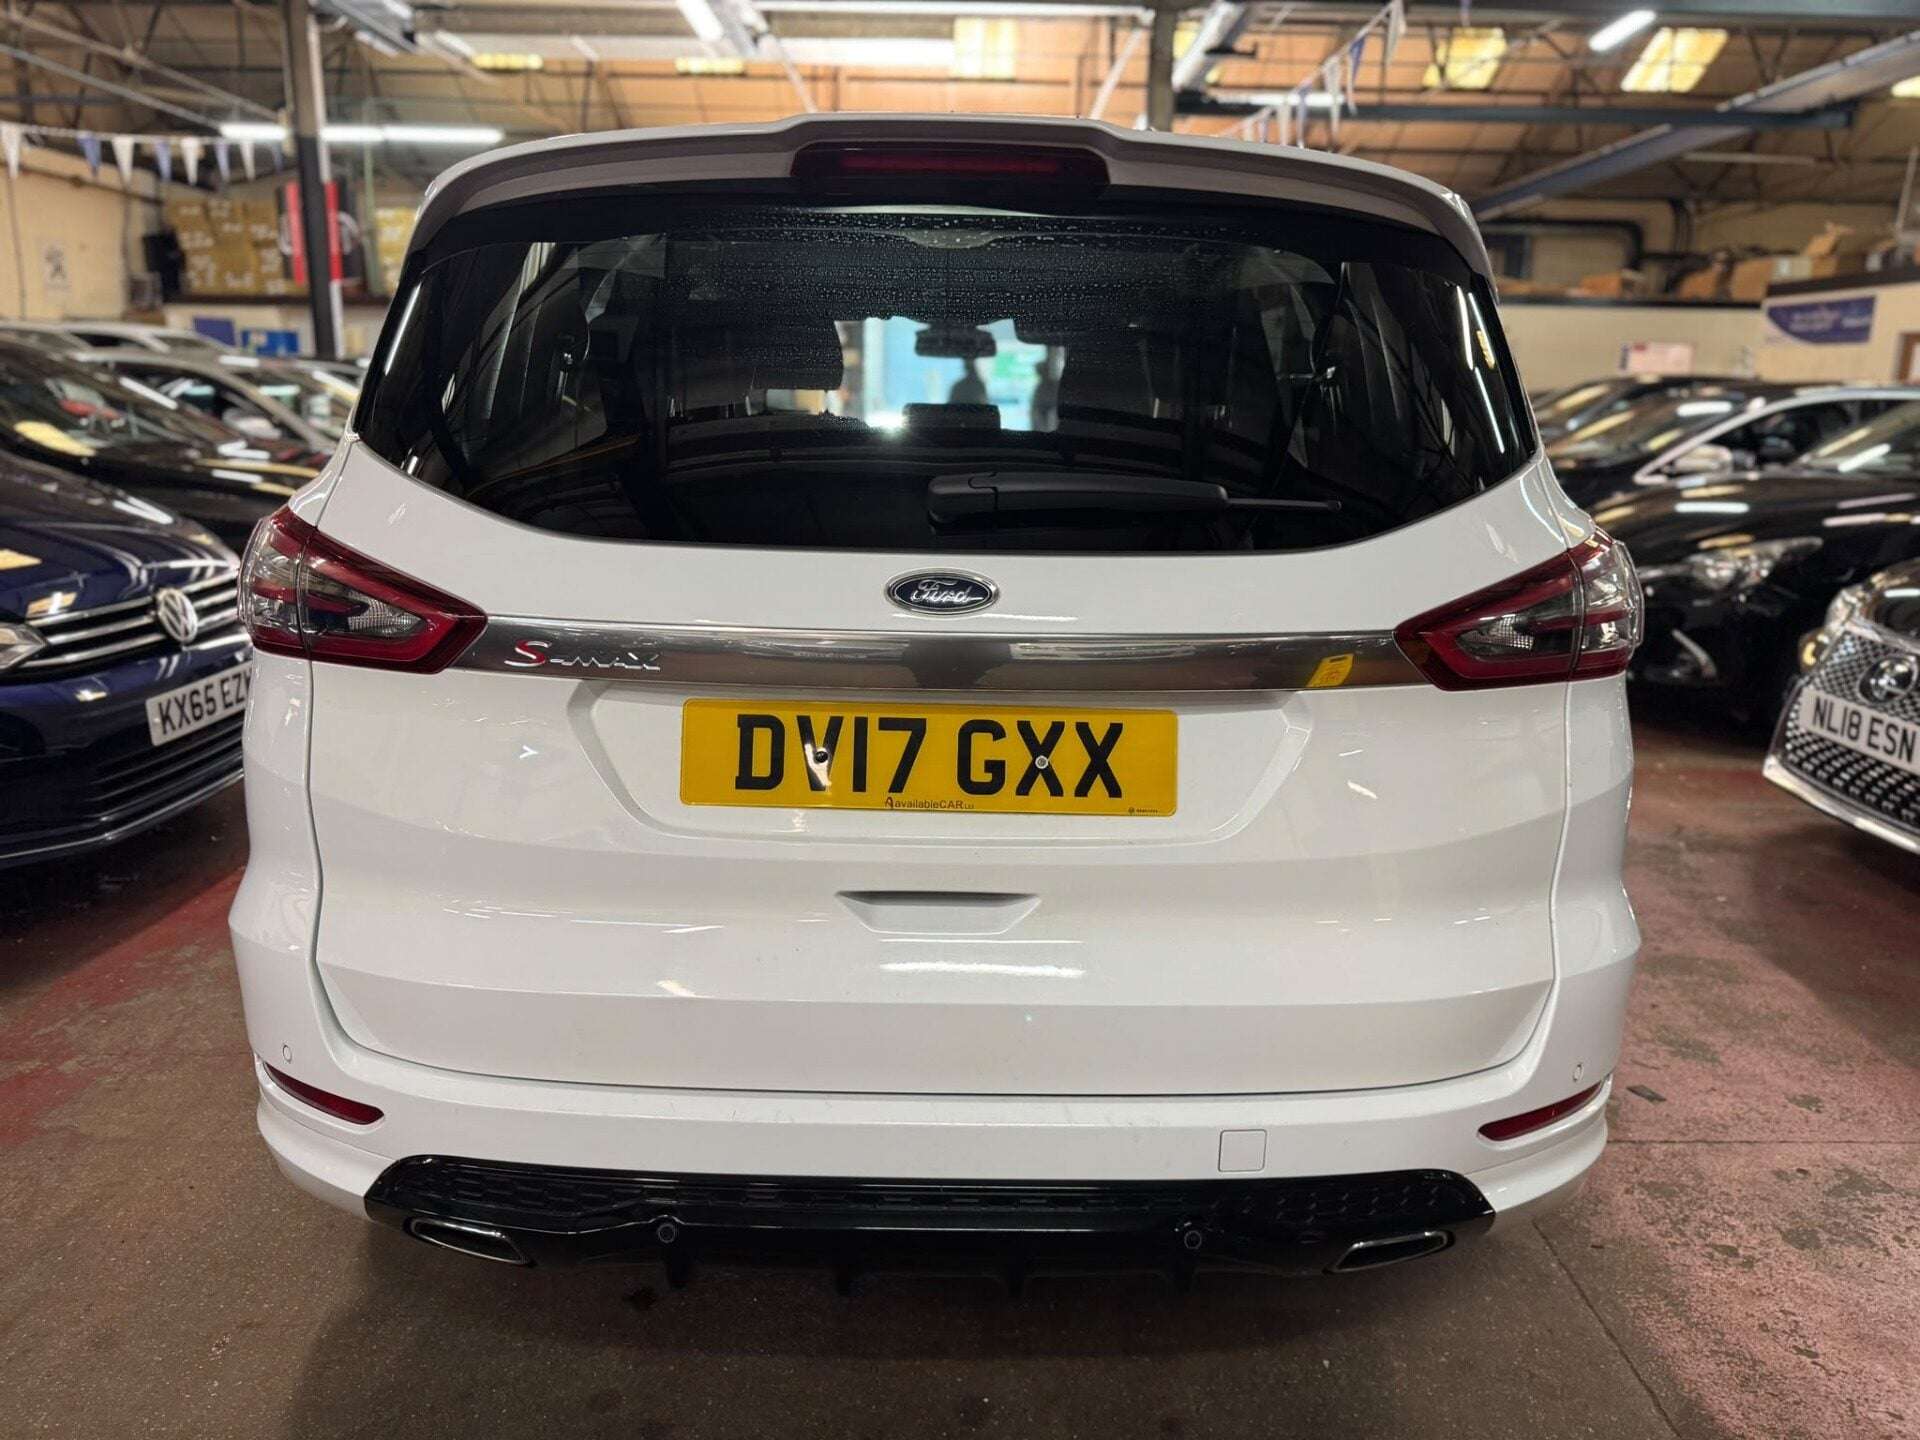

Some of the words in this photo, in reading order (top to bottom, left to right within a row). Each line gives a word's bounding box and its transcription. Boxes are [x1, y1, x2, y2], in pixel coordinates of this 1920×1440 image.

[910, 579, 984, 604] Ford
[158, 684, 217, 735] KX65
[1812, 696, 1862, 741] NL18
[1867, 714, 1917, 763] ESN
[735, 713, 927, 793] DV17
[957, 719, 1123, 799] GXX
